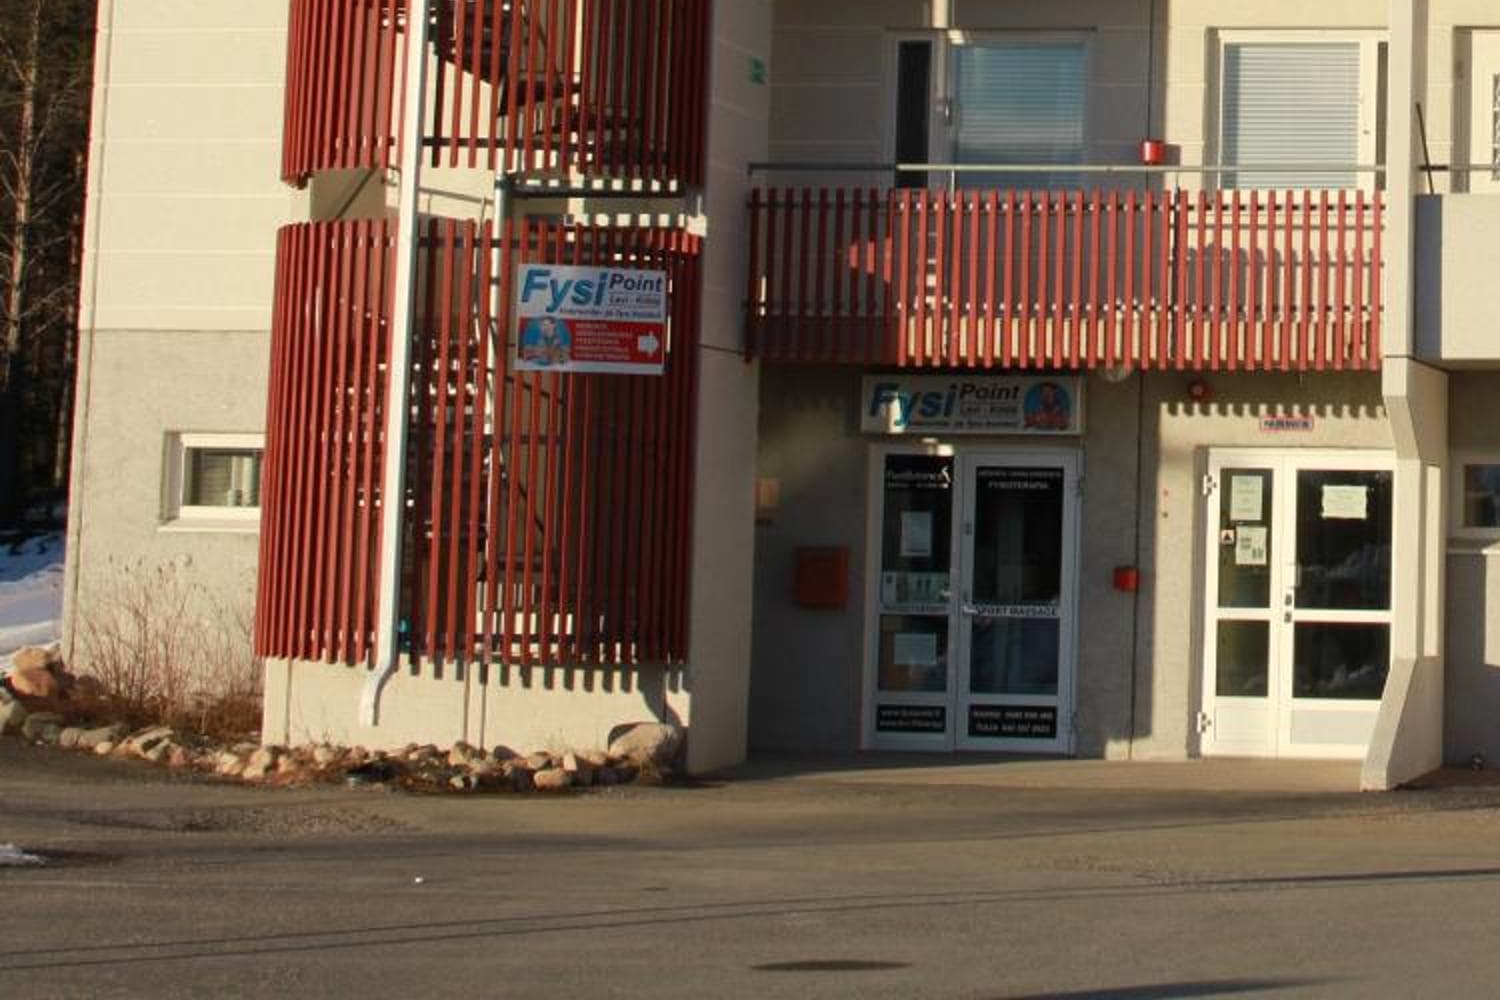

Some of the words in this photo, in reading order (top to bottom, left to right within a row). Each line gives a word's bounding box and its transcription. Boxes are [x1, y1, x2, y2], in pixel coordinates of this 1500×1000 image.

[521, 268, 609, 313] Fysi
[609, 273, 663, 293] Point
[870, 382, 957, 428] Fysi
[959, 382, 1021, 400] Point
